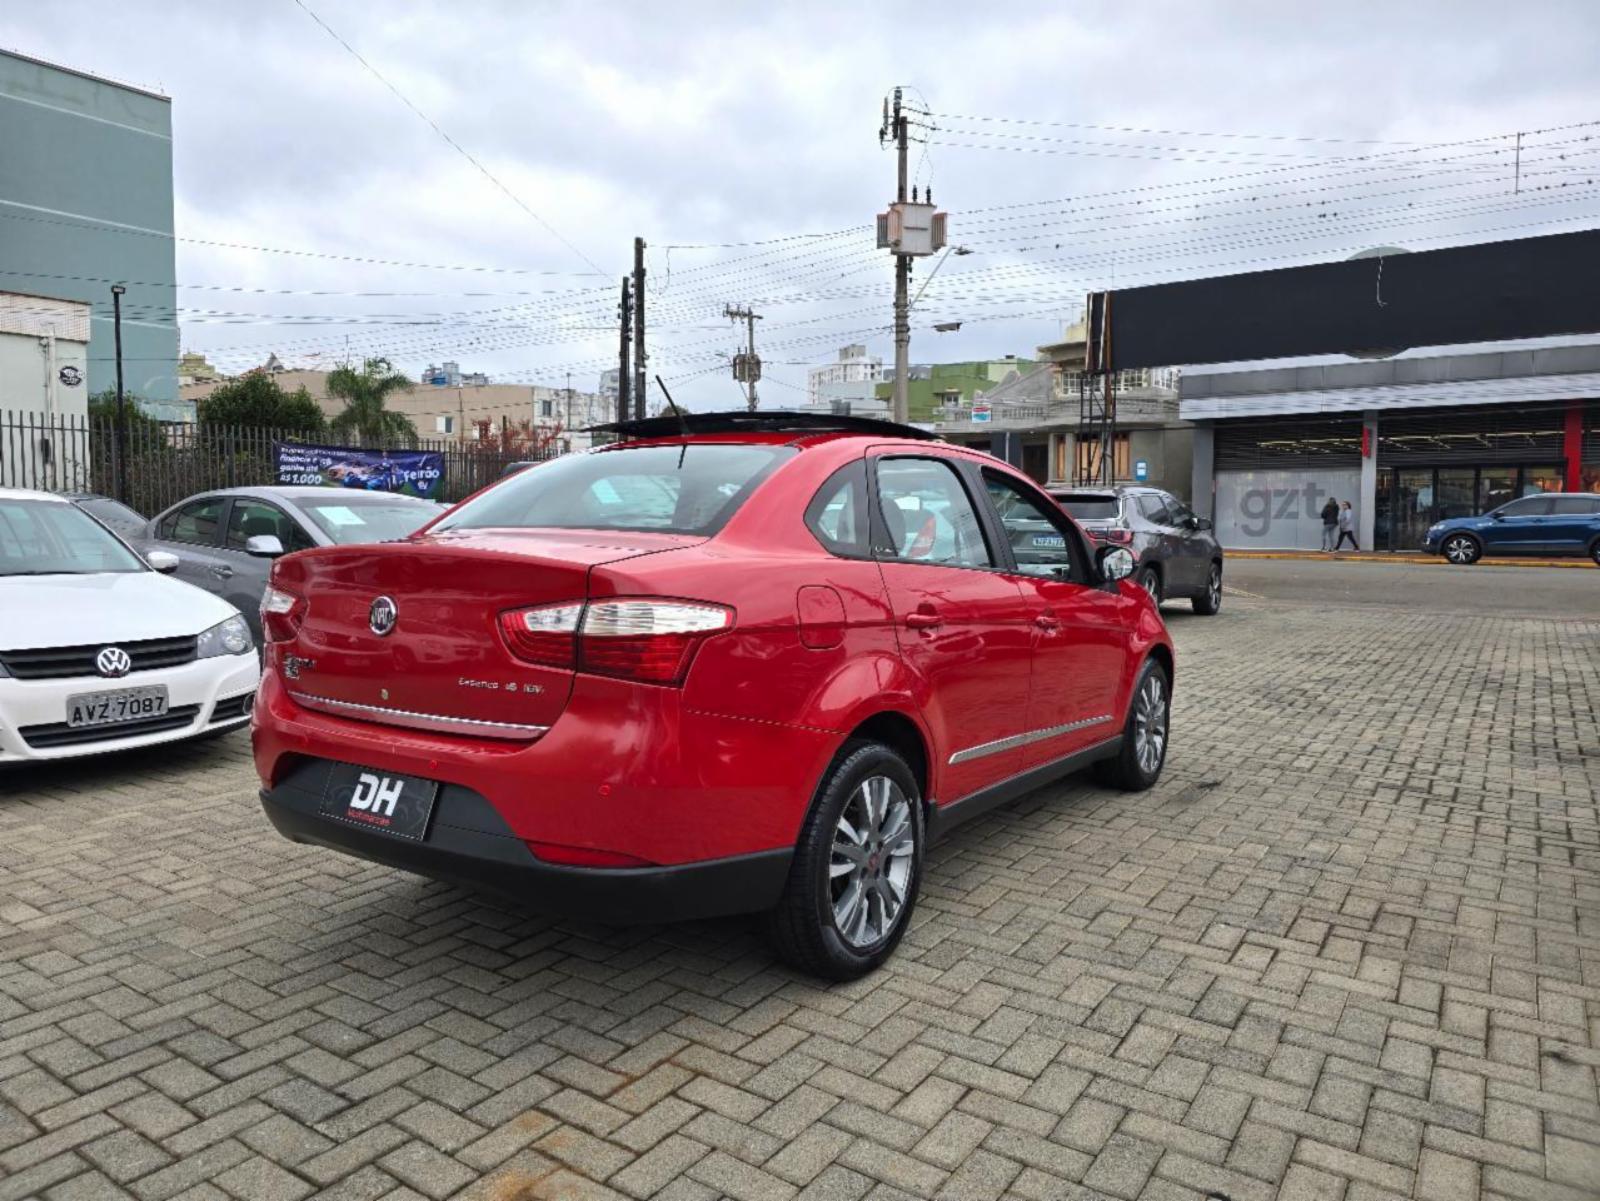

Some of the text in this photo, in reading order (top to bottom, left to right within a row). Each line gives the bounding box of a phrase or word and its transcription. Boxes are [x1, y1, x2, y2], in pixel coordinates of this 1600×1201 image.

[292, 474, 322, 484] 1.000
[1240, 482, 1326, 537] gzt
[349, 772, 404, 817] DH
